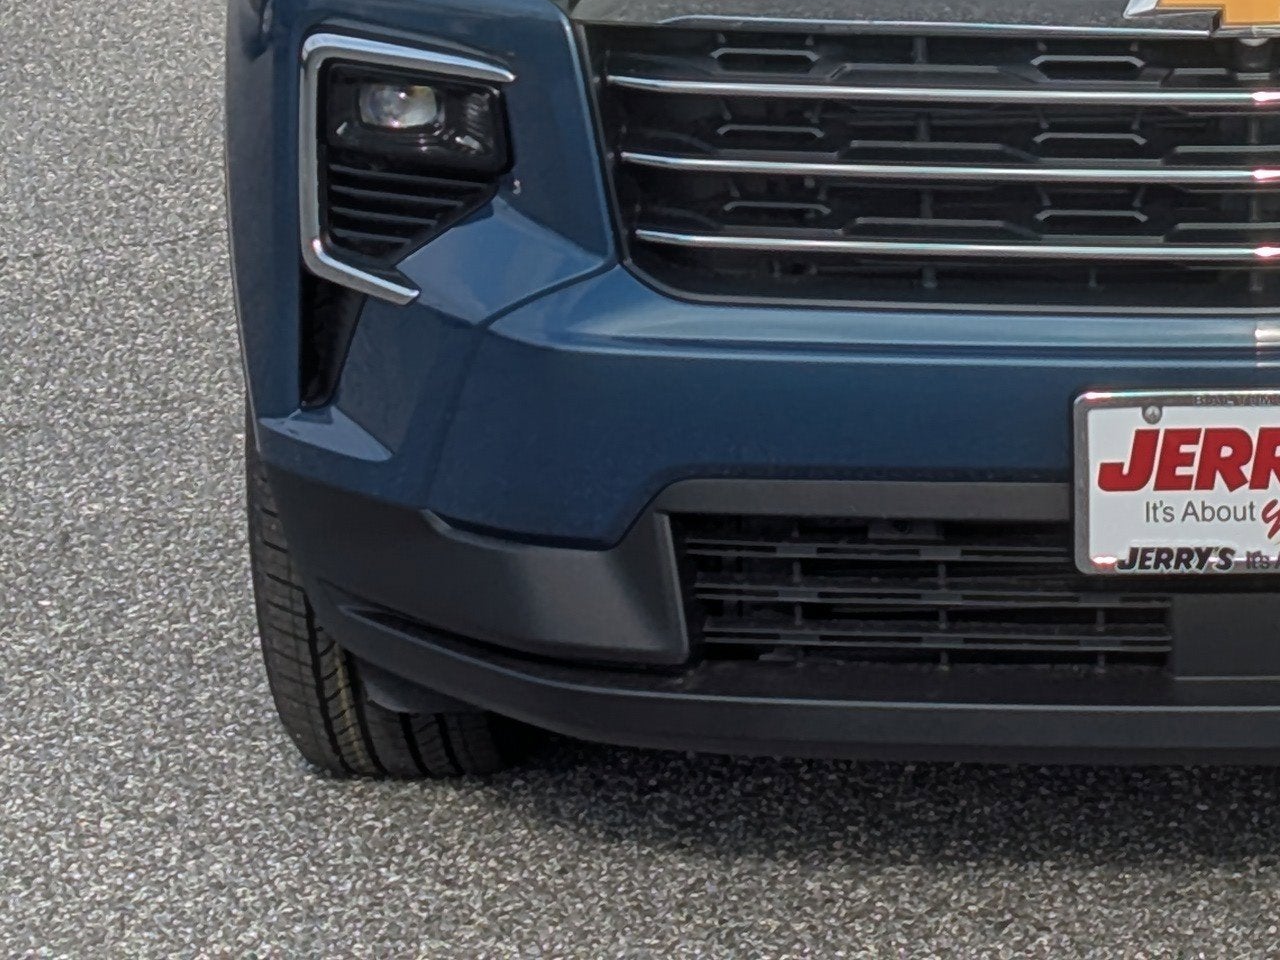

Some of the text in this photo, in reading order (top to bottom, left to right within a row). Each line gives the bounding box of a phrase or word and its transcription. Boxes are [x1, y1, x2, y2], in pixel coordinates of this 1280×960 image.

[1146, 500, 1175, 522] It's
[1181, 500, 1256, 522] About
[1117, 547, 1235, 570] JERRY'S
[1246, 550, 1270, 569] It's
